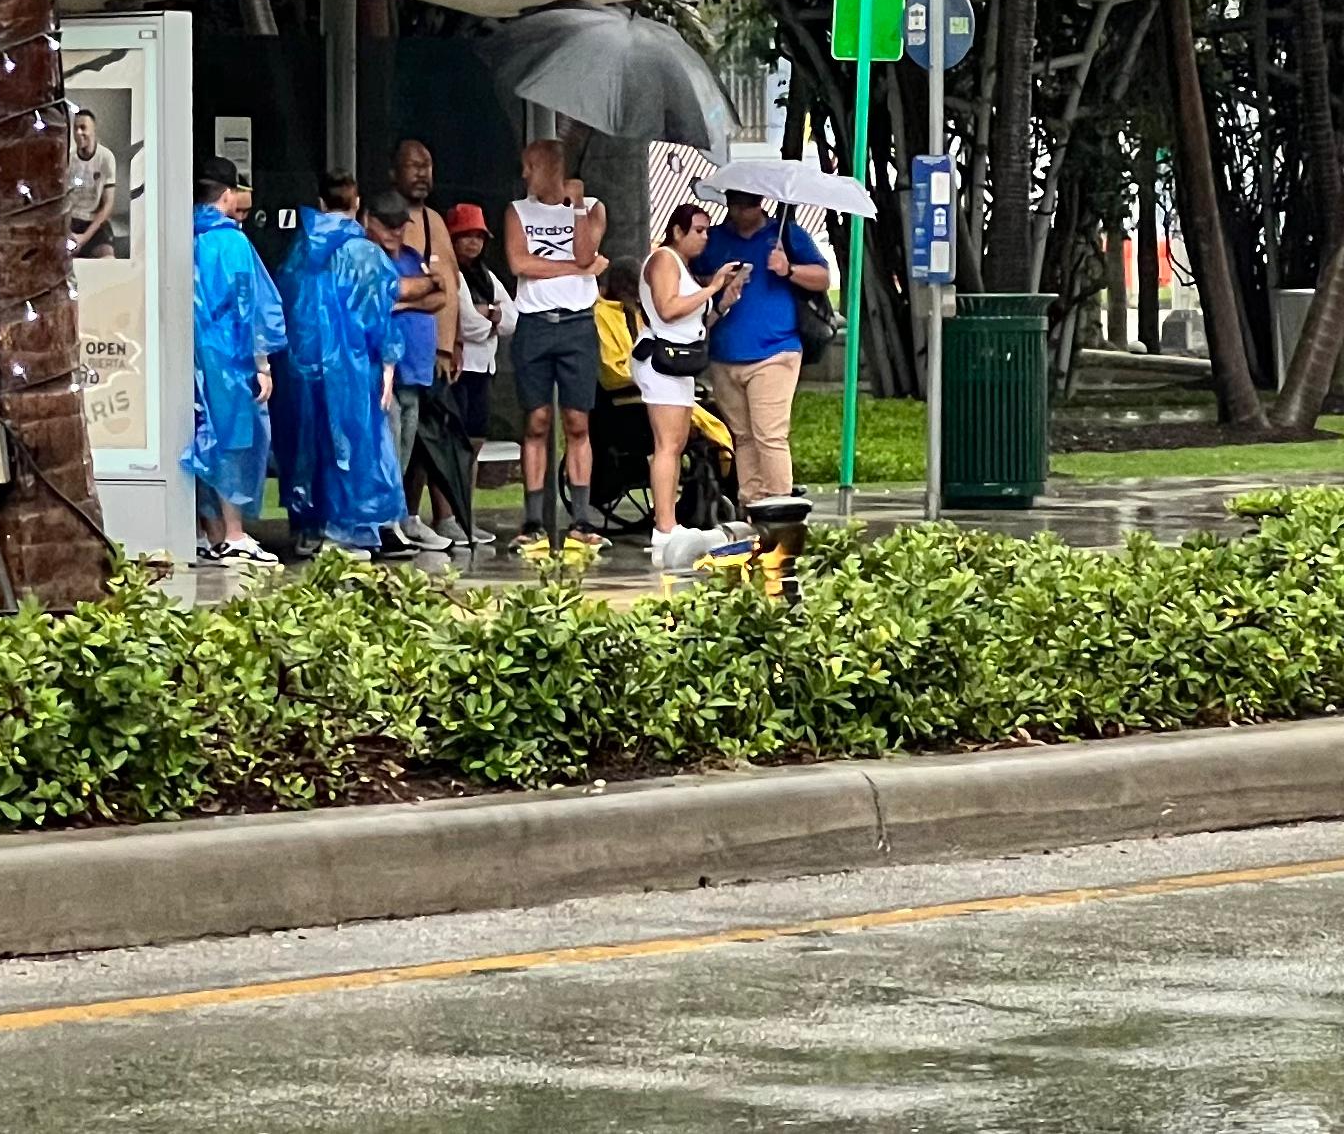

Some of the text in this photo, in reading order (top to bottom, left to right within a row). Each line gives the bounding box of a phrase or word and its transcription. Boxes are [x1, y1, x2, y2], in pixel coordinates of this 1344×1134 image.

[525, 226, 574, 236] Reebo
[86, 342, 126, 356] OPEN
[86, 390, 130, 424] RIS
